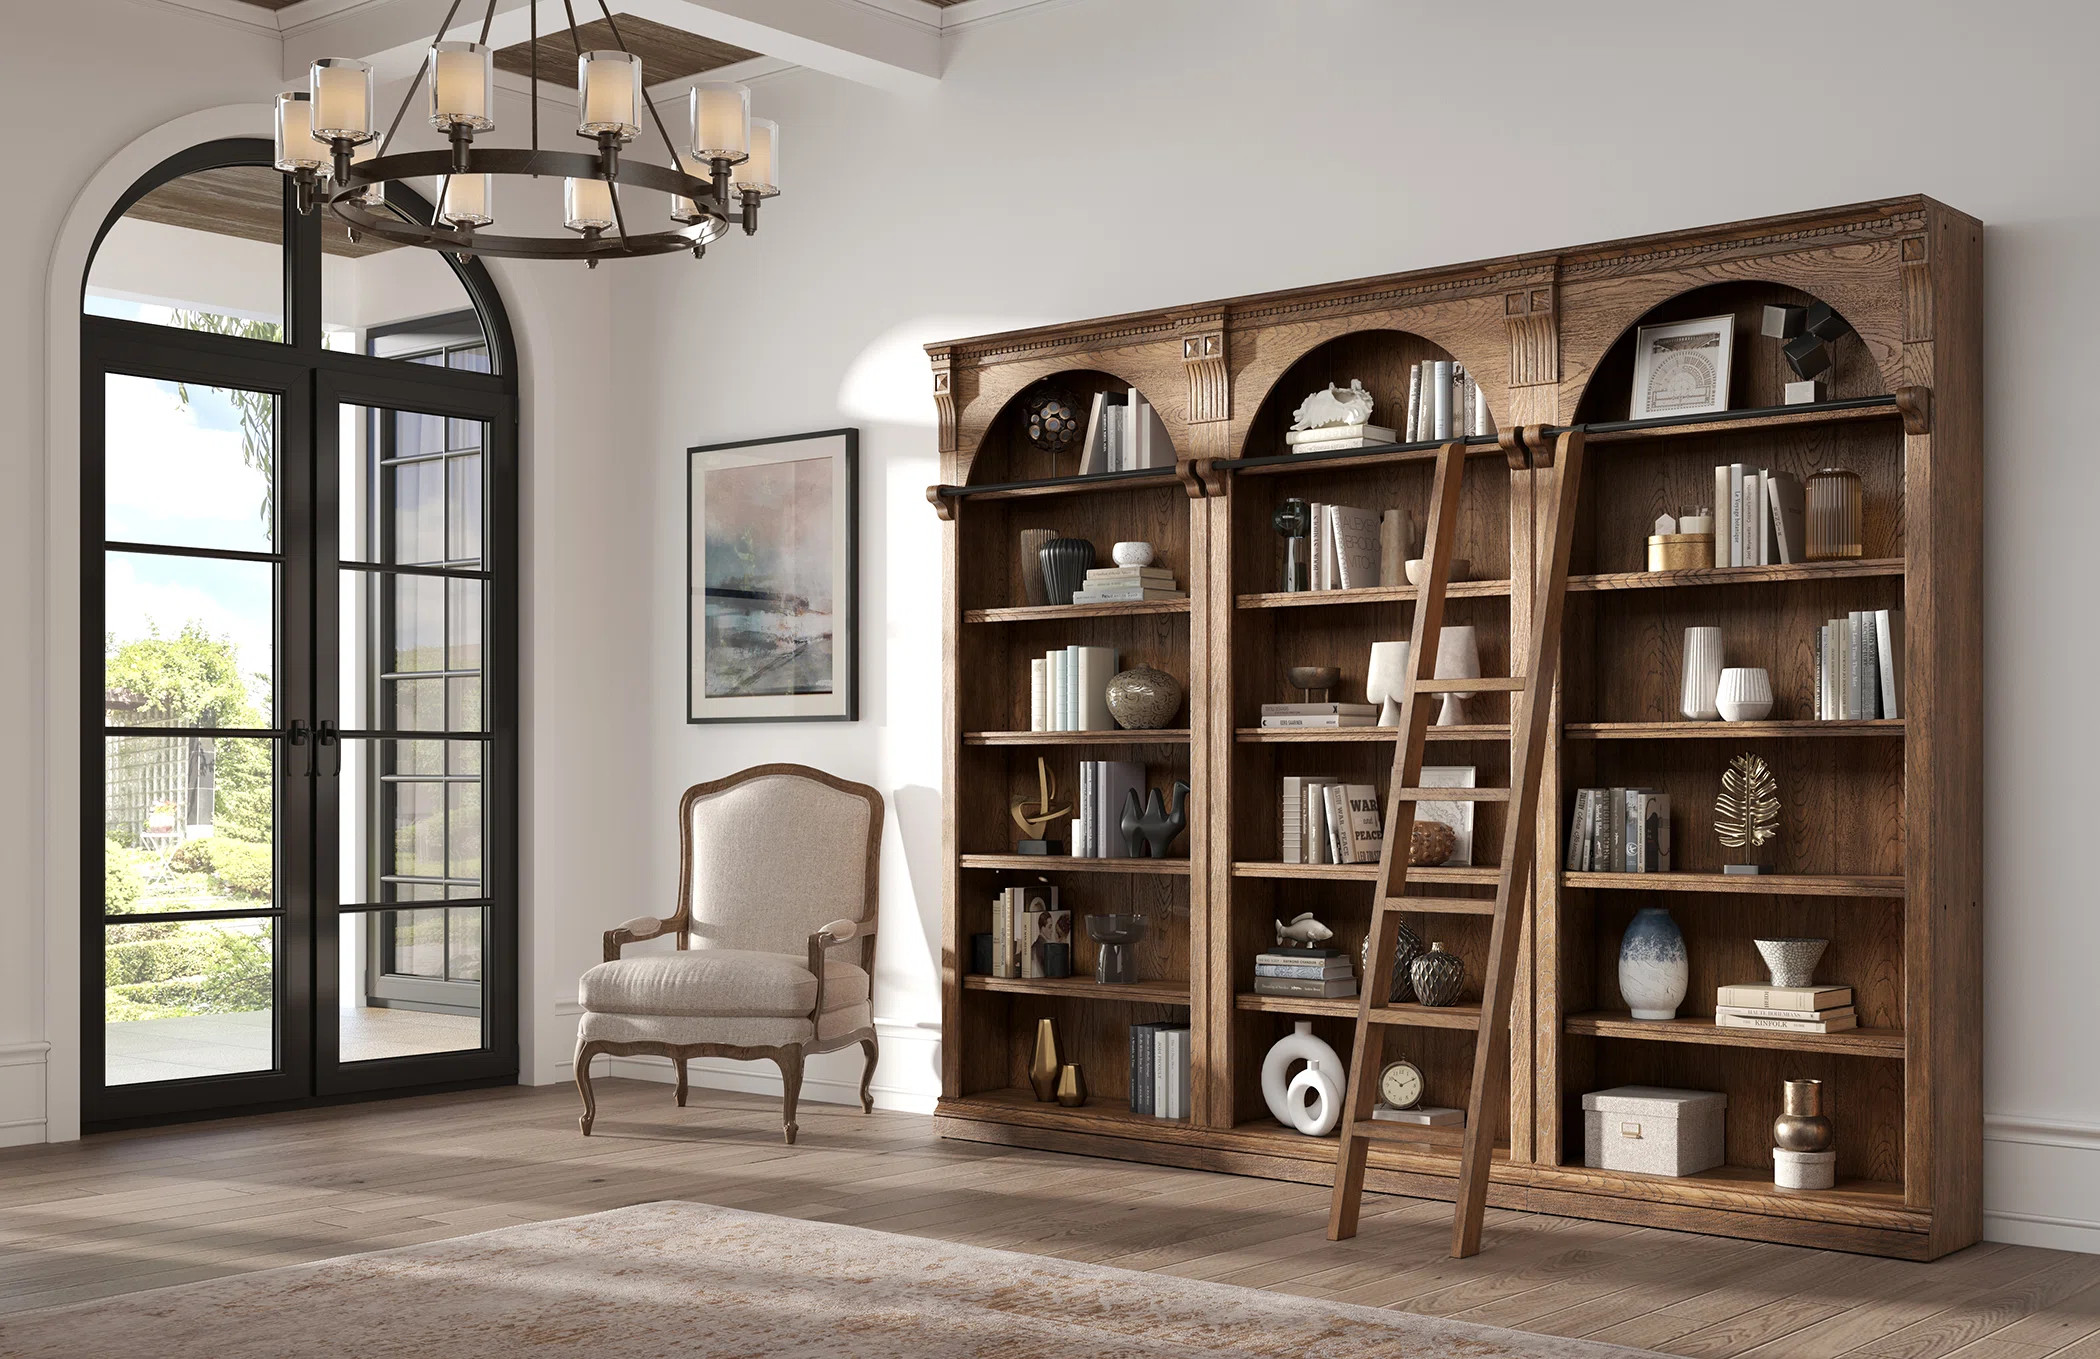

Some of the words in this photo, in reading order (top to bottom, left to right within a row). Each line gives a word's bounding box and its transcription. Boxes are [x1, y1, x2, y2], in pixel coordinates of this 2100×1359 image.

[1733, 498, 1741, 517] Voyage
[1343, 515, 1379, 532] ALEXEY
[1733, 518, 1741, 543] botanique
[1350, 799, 1378, 812] WAR
[1363, 816, 1374, 825] and
[1337, 806, 1345, 826] WAR
[1341, 831, 1350, 857] PEACE
[1355, 830, 1383, 841] PEACE
[1755, 1019, 1788, 1028] KINFOLK
